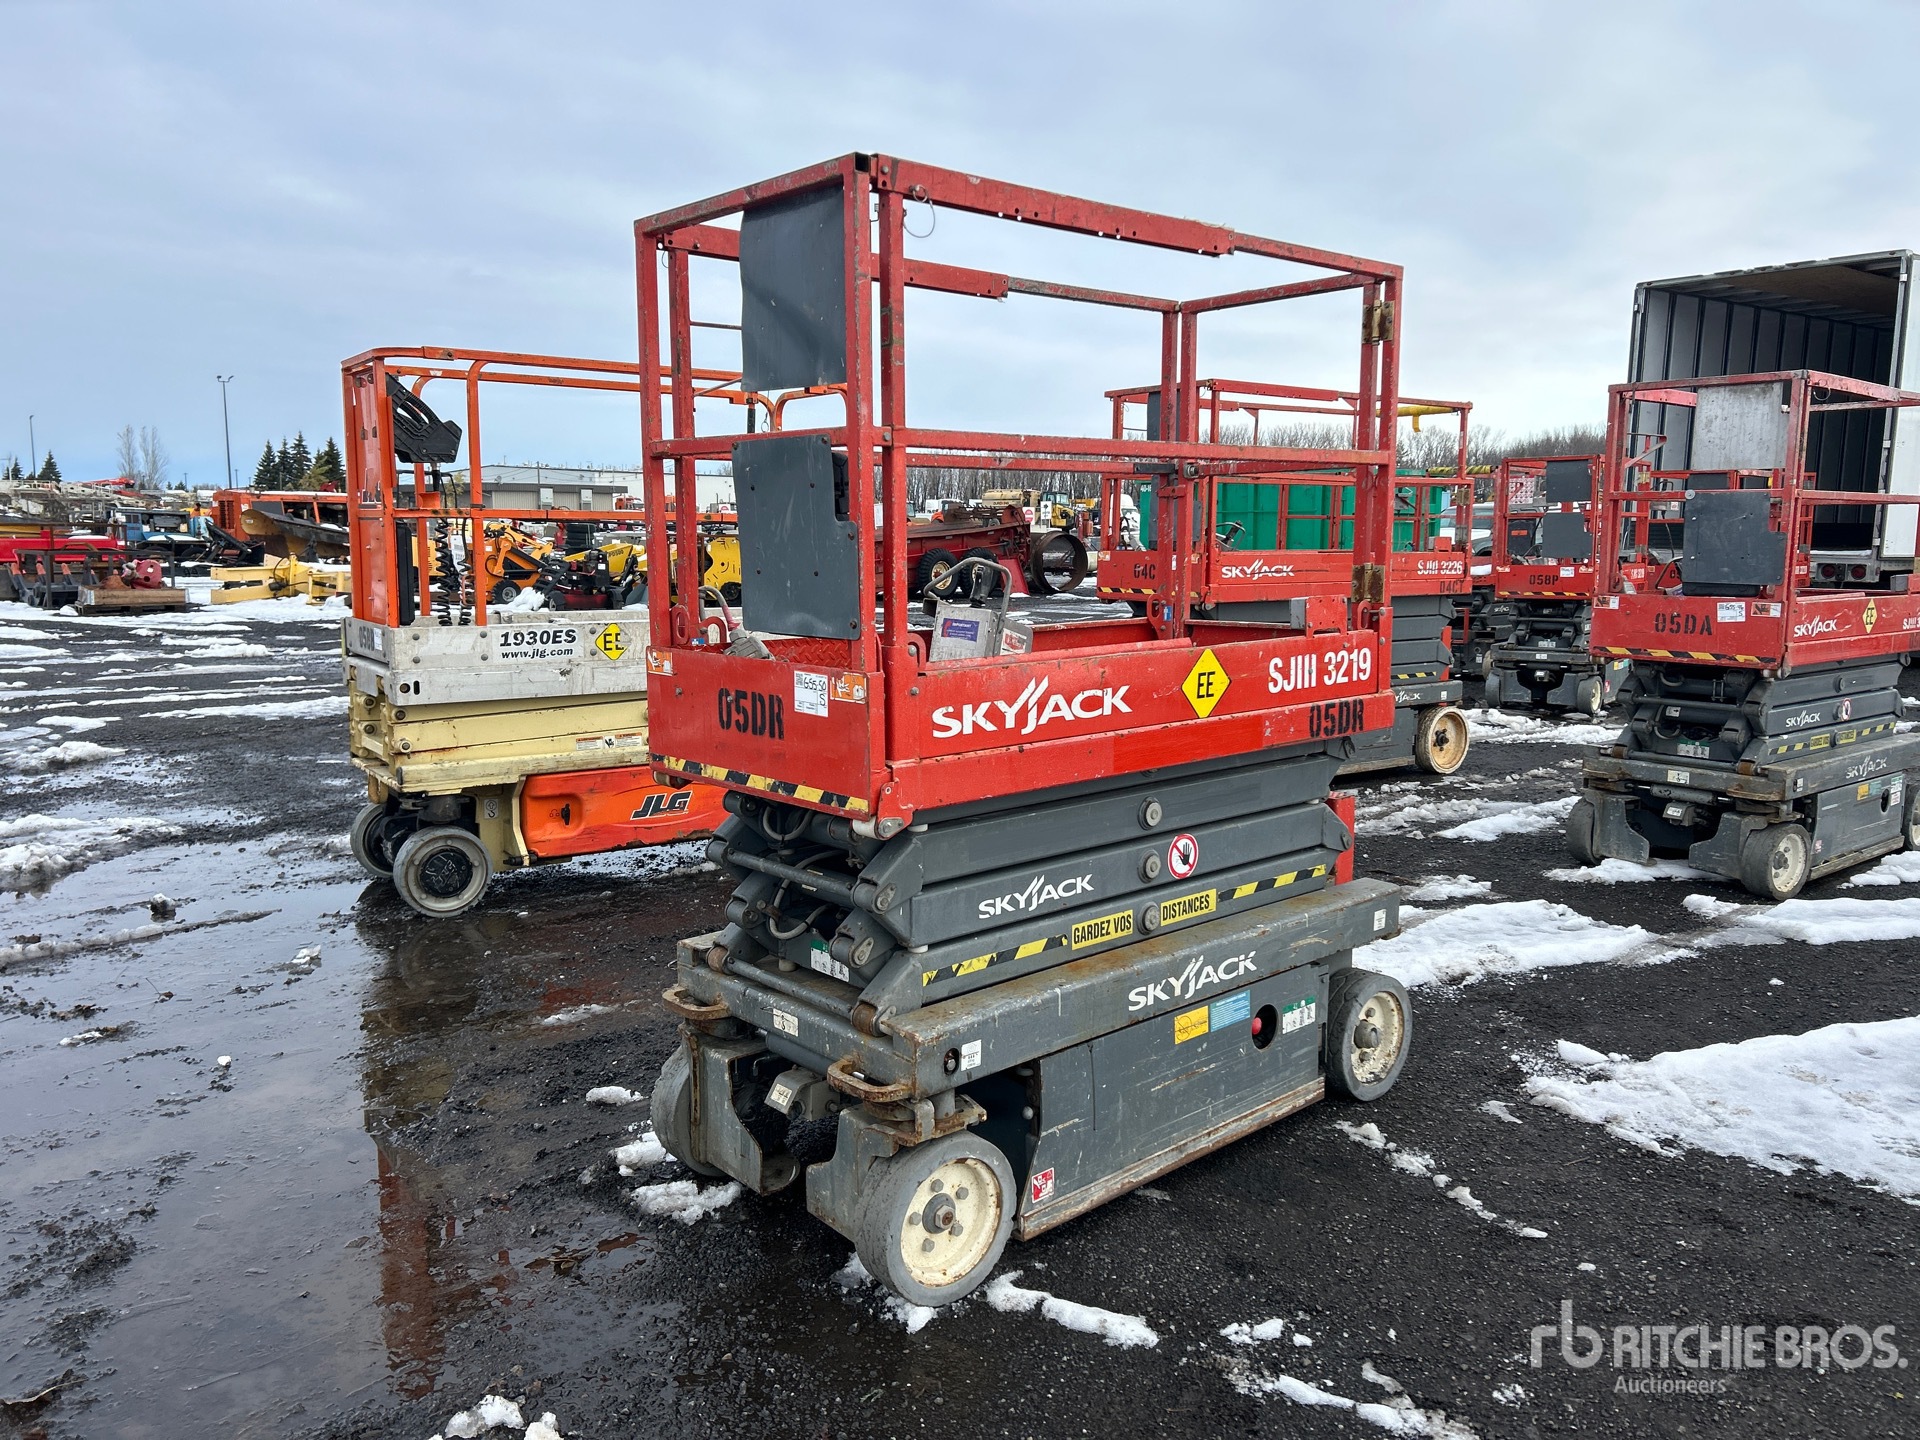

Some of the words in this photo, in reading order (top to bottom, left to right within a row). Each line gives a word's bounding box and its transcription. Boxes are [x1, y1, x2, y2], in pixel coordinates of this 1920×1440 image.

[1221, 559, 1295, 581] SKYJACK
[1440, 560, 1463, 575] 3226
[1655, 612, 1713, 636] 05DA
[1793, 615, 1838, 638] SKYJACK
[1865, 607, 1875, 625] EE
[500, 628, 577, 647] 1930ES
[501, 648, 574, 660] www.jlg.com
[1323, 647, 1372, 686] 3219
[1196, 671, 1215, 700] EE
[718, 687, 785, 740] 05DR
[931, 674, 1133, 738] SKYJACK
[1309, 698, 1364, 738] 05DR
[1785, 709, 1821, 727] SKYJACK
[1845, 755, 1888, 779] SKYJACK
[630, 790, 693, 820] JLG
[978, 873, 1095, 919] SKYJACK
[1073, 919, 1111, 945] GARDEZ
[1113, 914, 1132, 933] VOS
[1162, 894, 1210, 922] DISTANCES
[1128, 950, 1258, 1012] SKYJACK
